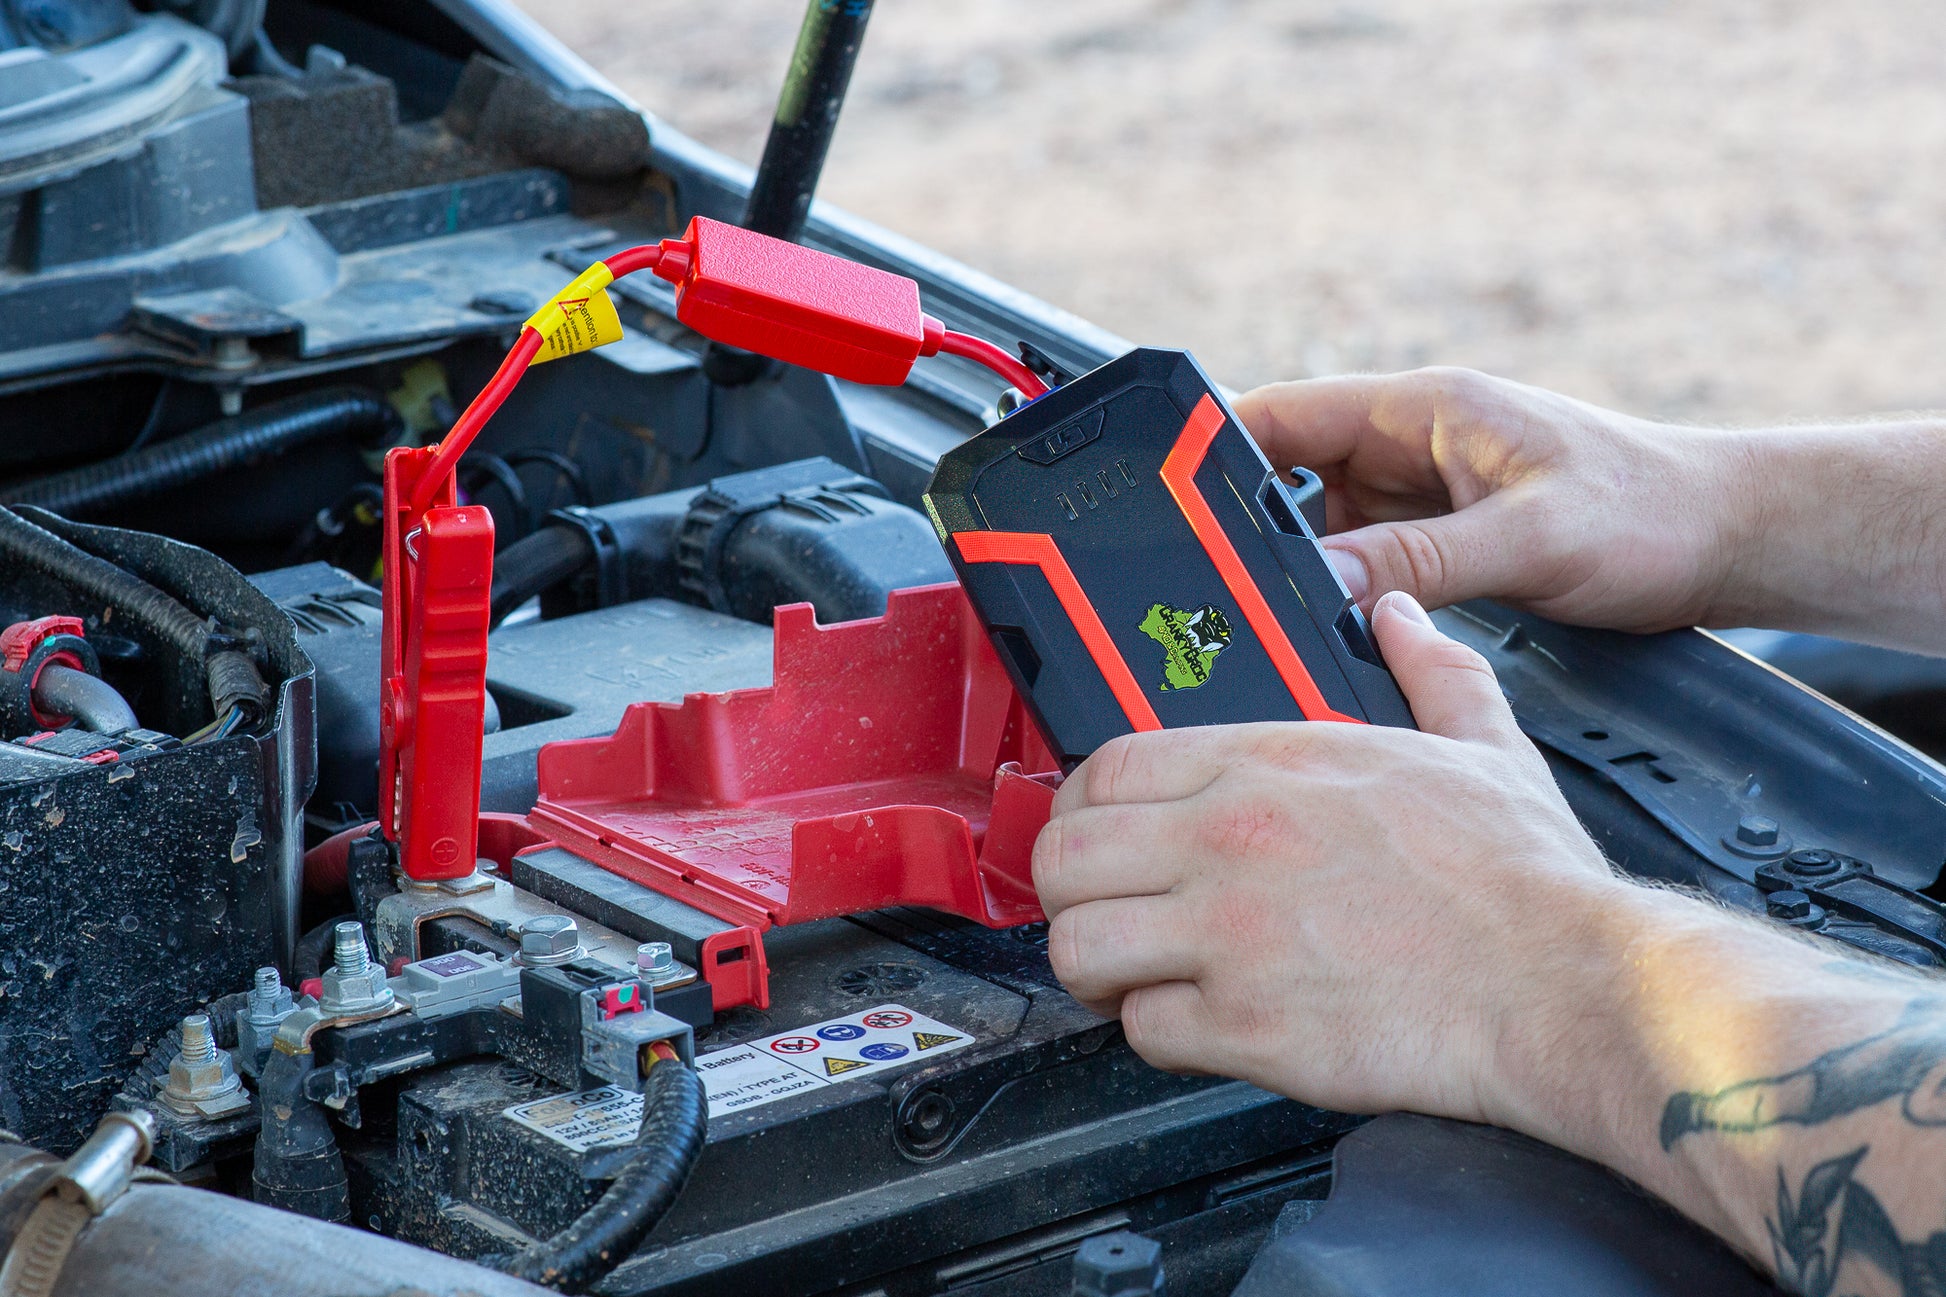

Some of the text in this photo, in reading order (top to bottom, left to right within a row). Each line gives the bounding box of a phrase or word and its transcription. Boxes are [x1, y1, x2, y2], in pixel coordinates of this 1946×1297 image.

[1158, 606, 1207, 682] CRANKY CROC
[702, 1051, 756, 1070] Battery
[708, 1088, 737, 1102] (EN)
[743, 1077, 782, 1091] TYPE
[781, 1071, 798, 1081] AT
[726, 1094, 763, 1107] GSDB
